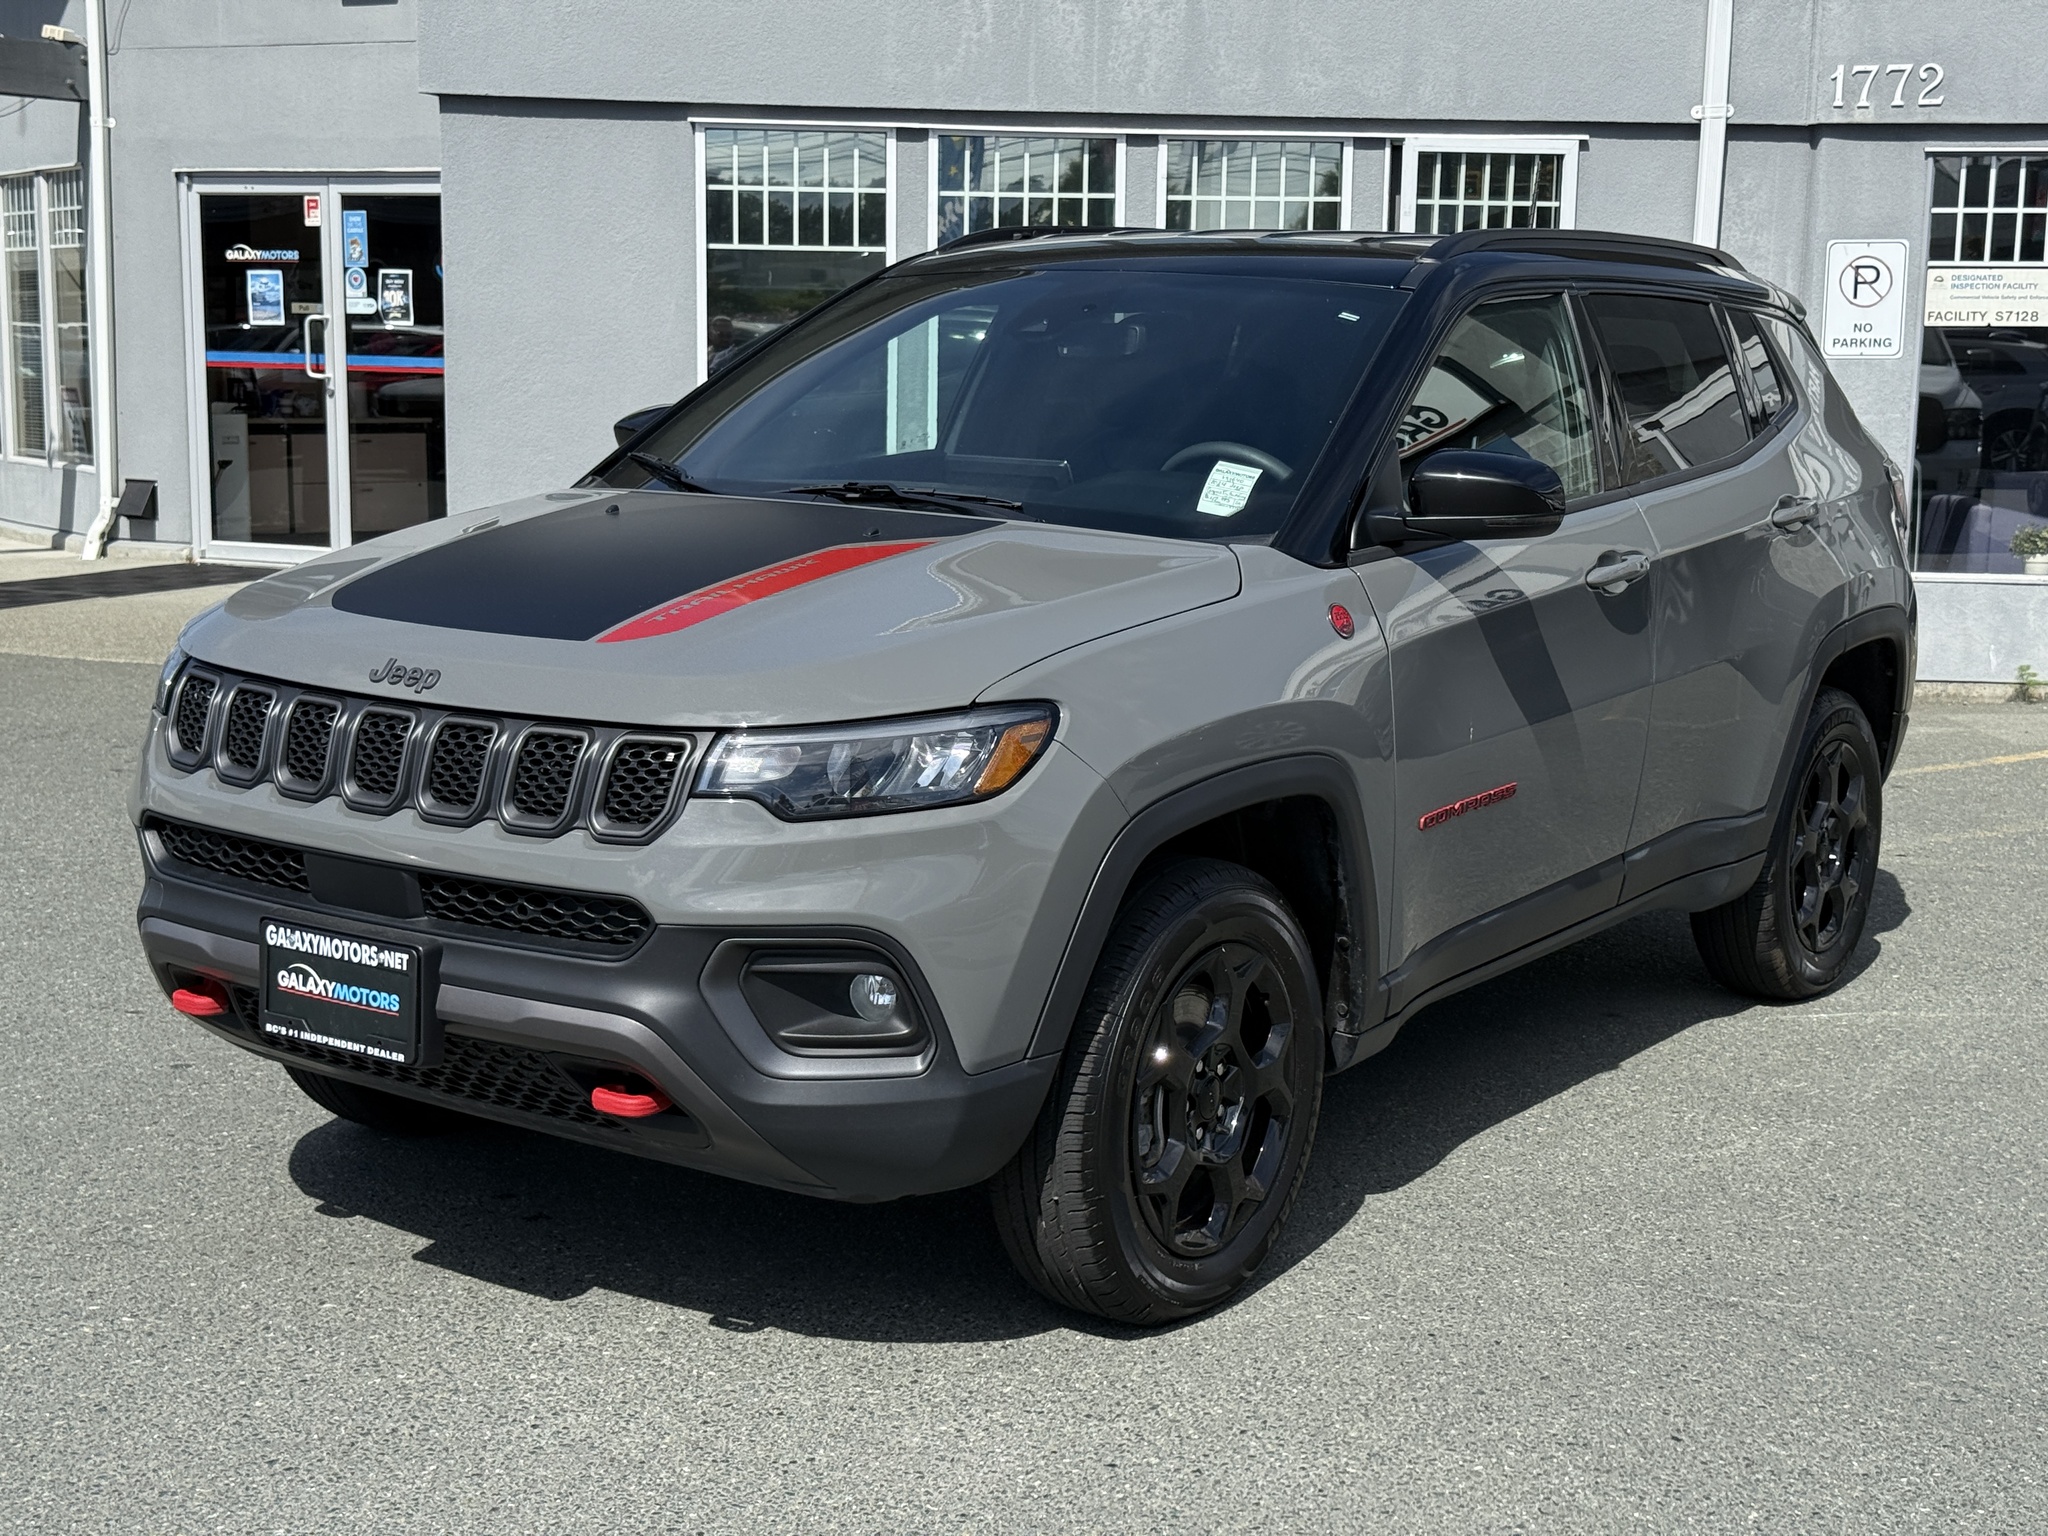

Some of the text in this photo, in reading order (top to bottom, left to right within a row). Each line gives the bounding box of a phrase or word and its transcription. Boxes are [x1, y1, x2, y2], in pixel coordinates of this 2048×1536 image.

[1830, 62, 1946, 108] 1772
[225, 248, 300, 261] GALAXYMOTORS
[1951, 274, 2004, 282] DESIGNATED
[1950, 282, 2000, 290] INSPECTION
[2002, 282, 2039, 290] FACILITY
[1927, 311, 2039, 322] FACILITY S7128
[1853, 322, 1873, 333] NO
[1832, 337, 1893, 348] PARKING
[368, 657, 442, 695] Jeep
[1418, 781, 1519, 832] COMPASS
[277, 968, 401, 1012] GALAXYMOTORS
[265, 1023, 287, 1036] BC'S
[300, 1030, 366, 1054] INDEPENDENT
[367, 1045, 405, 1063] DEALER
